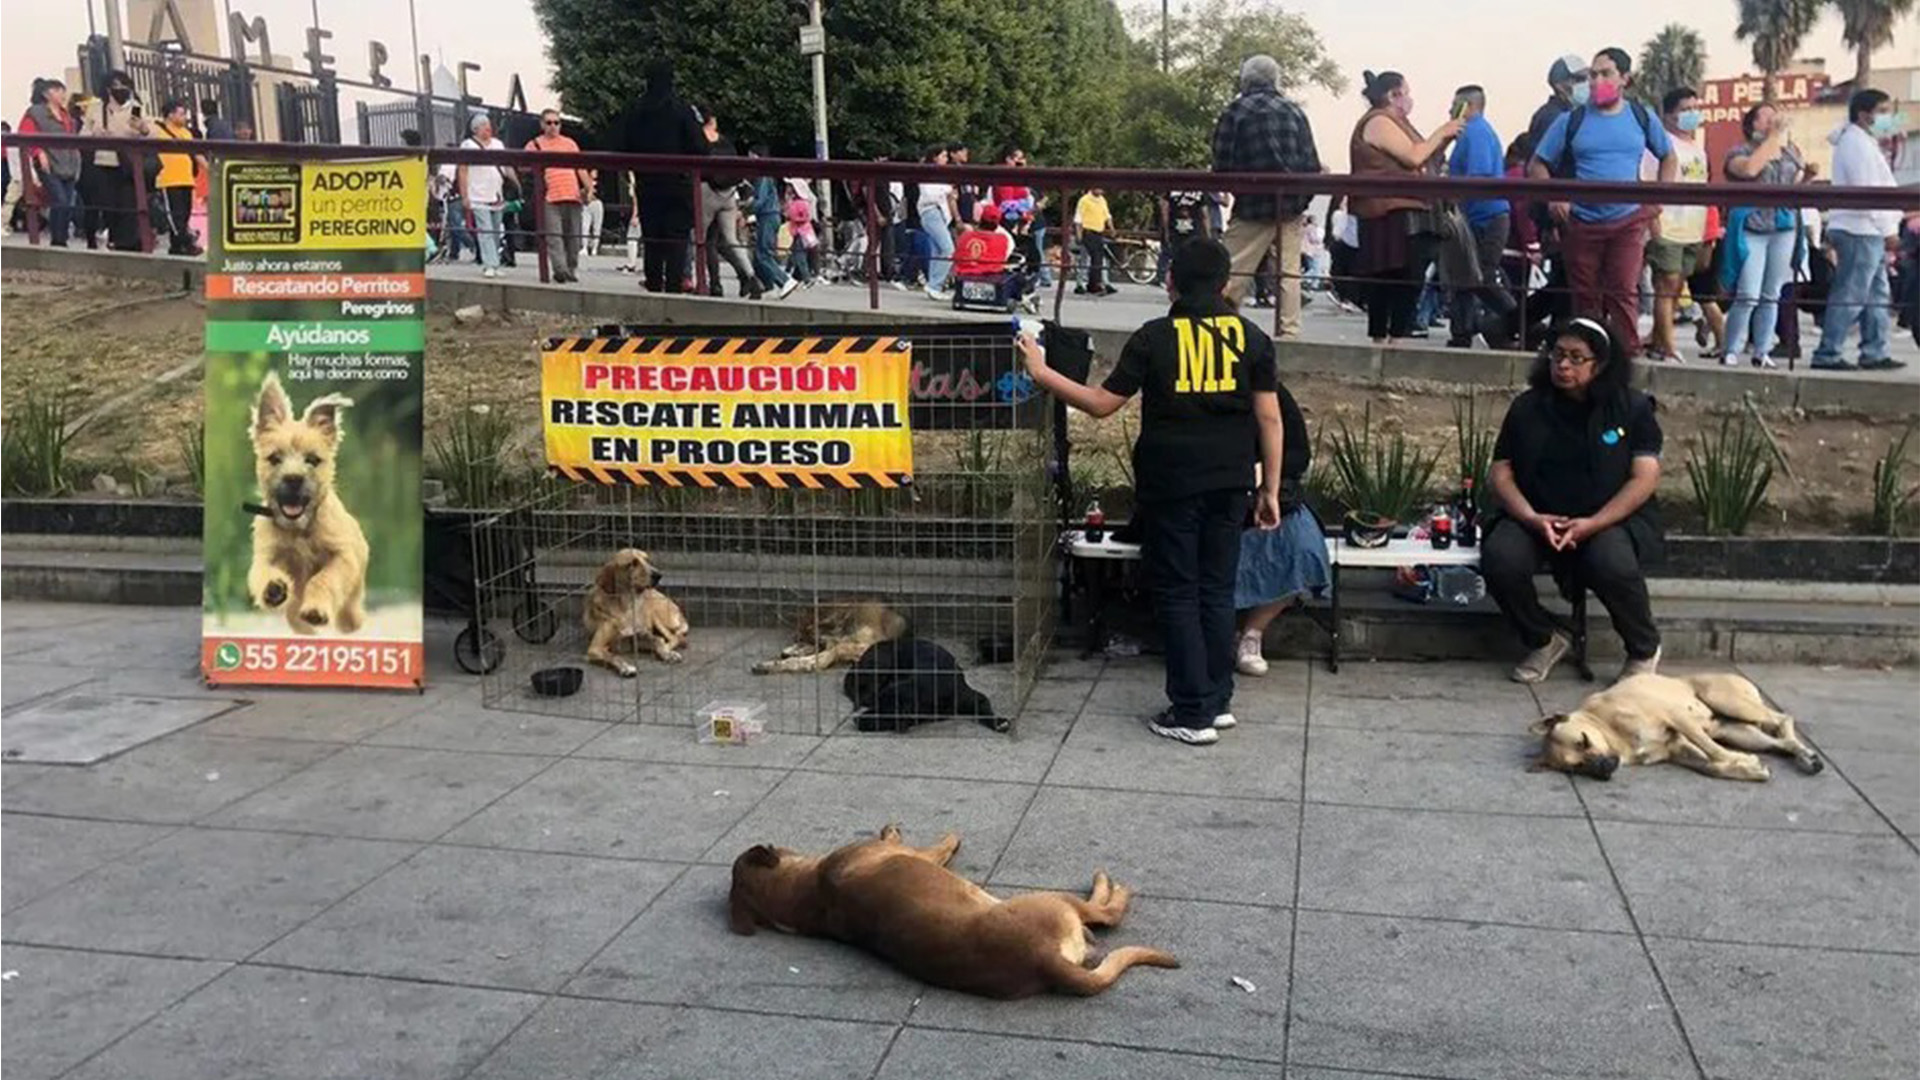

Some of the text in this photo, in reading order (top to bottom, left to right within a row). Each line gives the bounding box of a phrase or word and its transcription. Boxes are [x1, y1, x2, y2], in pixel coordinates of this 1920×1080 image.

[1733, 78, 1808, 102] PELA
[312, 170, 404, 191] ADOPTA
[312, 193, 403, 219] un perrito
[309, 218, 416, 237] PEREGRINO
[221, 259, 342, 272] Justo ahora estamos
[232, 276, 410, 294] Rescatando Perritos
[341, 301, 415, 318] Peregrinos
[266, 323, 370, 350] Ayúdanos
[288, 353, 411, 369] Hay muchas formas,
[313, 369, 325, 380] te
[327, 368, 373, 380] decimos
[584, 361, 857, 392] PRECAUCIÓN
[551, 399, 903, 429] RESCATE ANIMAL
[592, 437, 851, 466] EN PROCESO
[245, 644, 411, 674] 55 22195151
